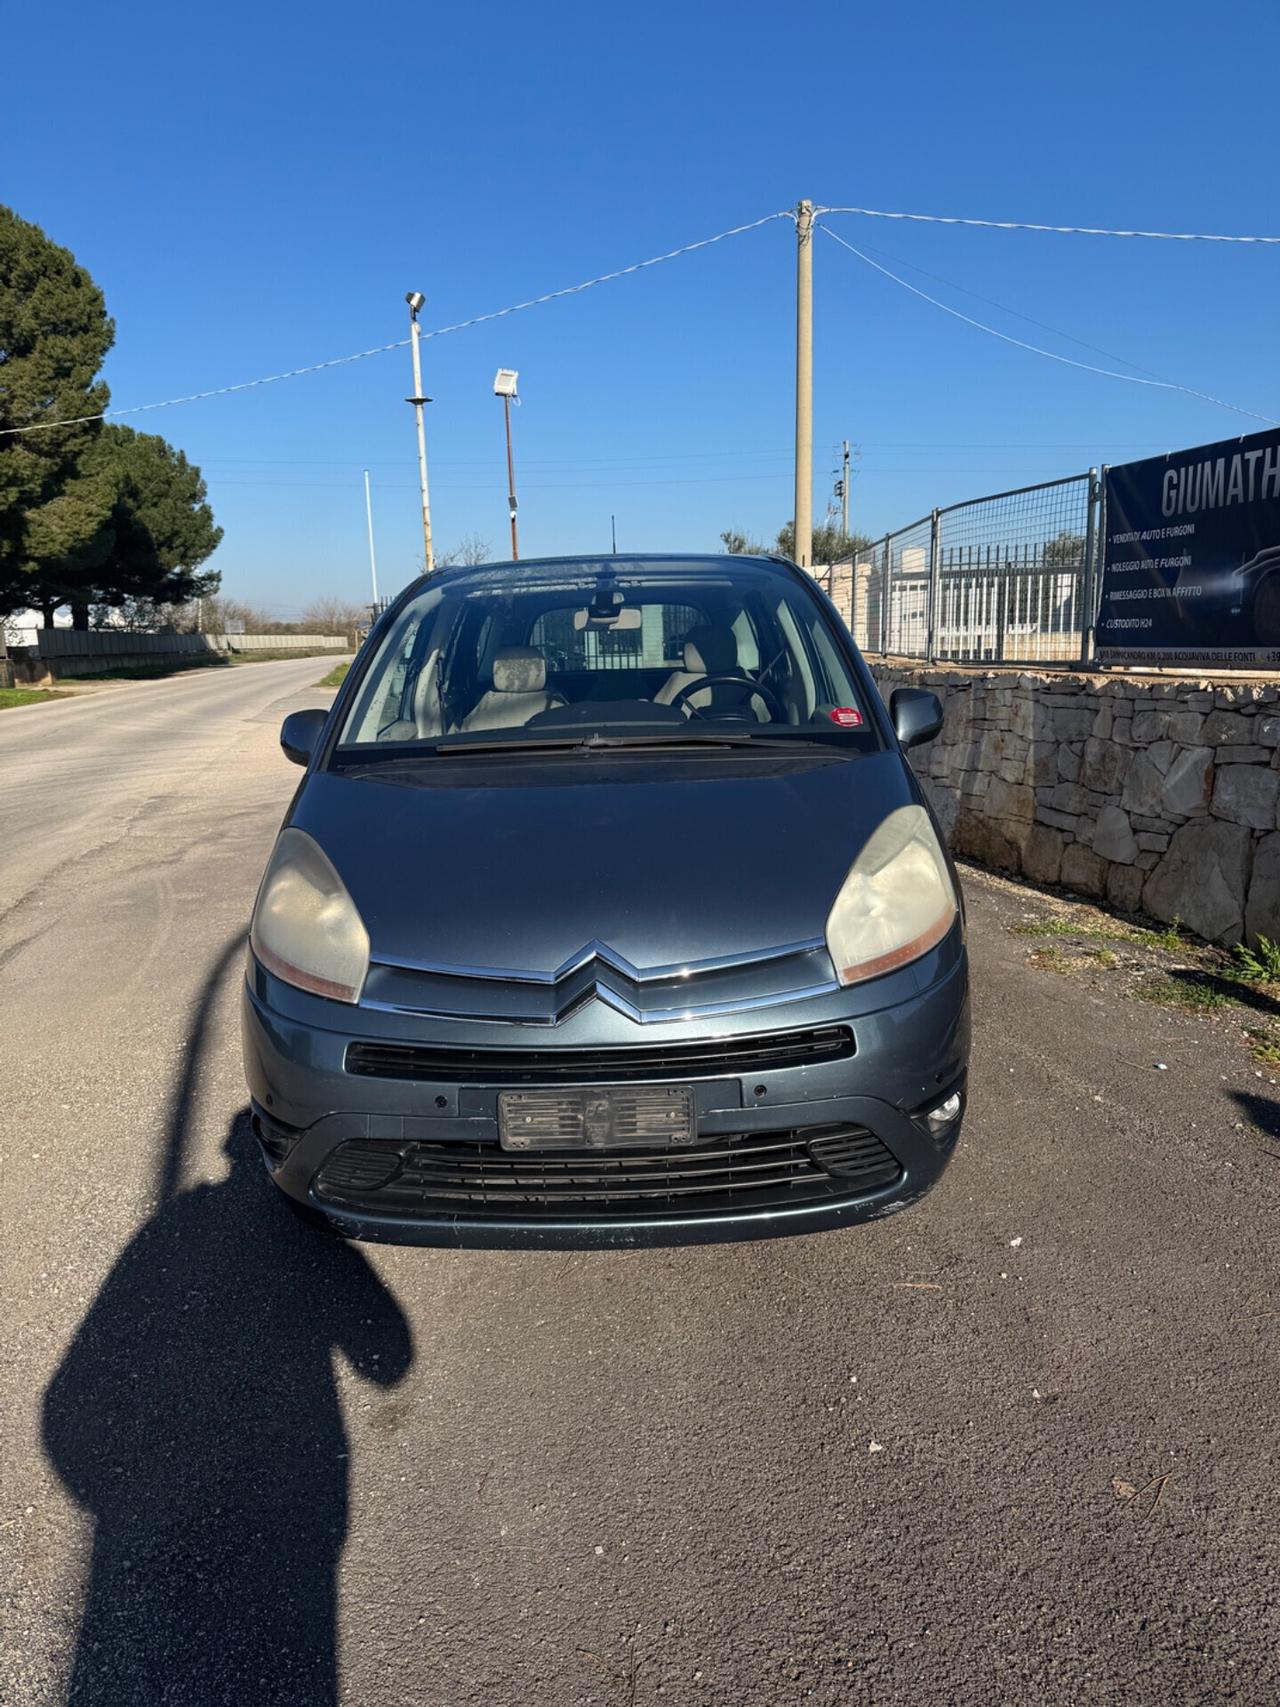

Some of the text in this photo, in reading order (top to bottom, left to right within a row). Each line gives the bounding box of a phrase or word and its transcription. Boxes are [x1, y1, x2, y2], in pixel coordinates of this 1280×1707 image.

[1162, 445, 1280, 517] GIUMATH
[1141, 529, 1160, 541] AUTO
[1161, 529, 1166, 538] E
[1166, 524, 1195, 537] FURGONI
[1111, 555, 1192, 572] NOLEGGIO AUTO E FURGONI
[1109, 590, 1148, 600] RIMESSAGGIO
[1148, 589, 1152, 598] E
[1153, 588, 1165, 598] BOX
[1172, 586, 1202, 596] AFFITTO
[1106, 618, 1152, 628] CUSTODITO H24
[1212, 652, 1232, 662] DELLE
[1233, 652, 1256, 662] FONTI
